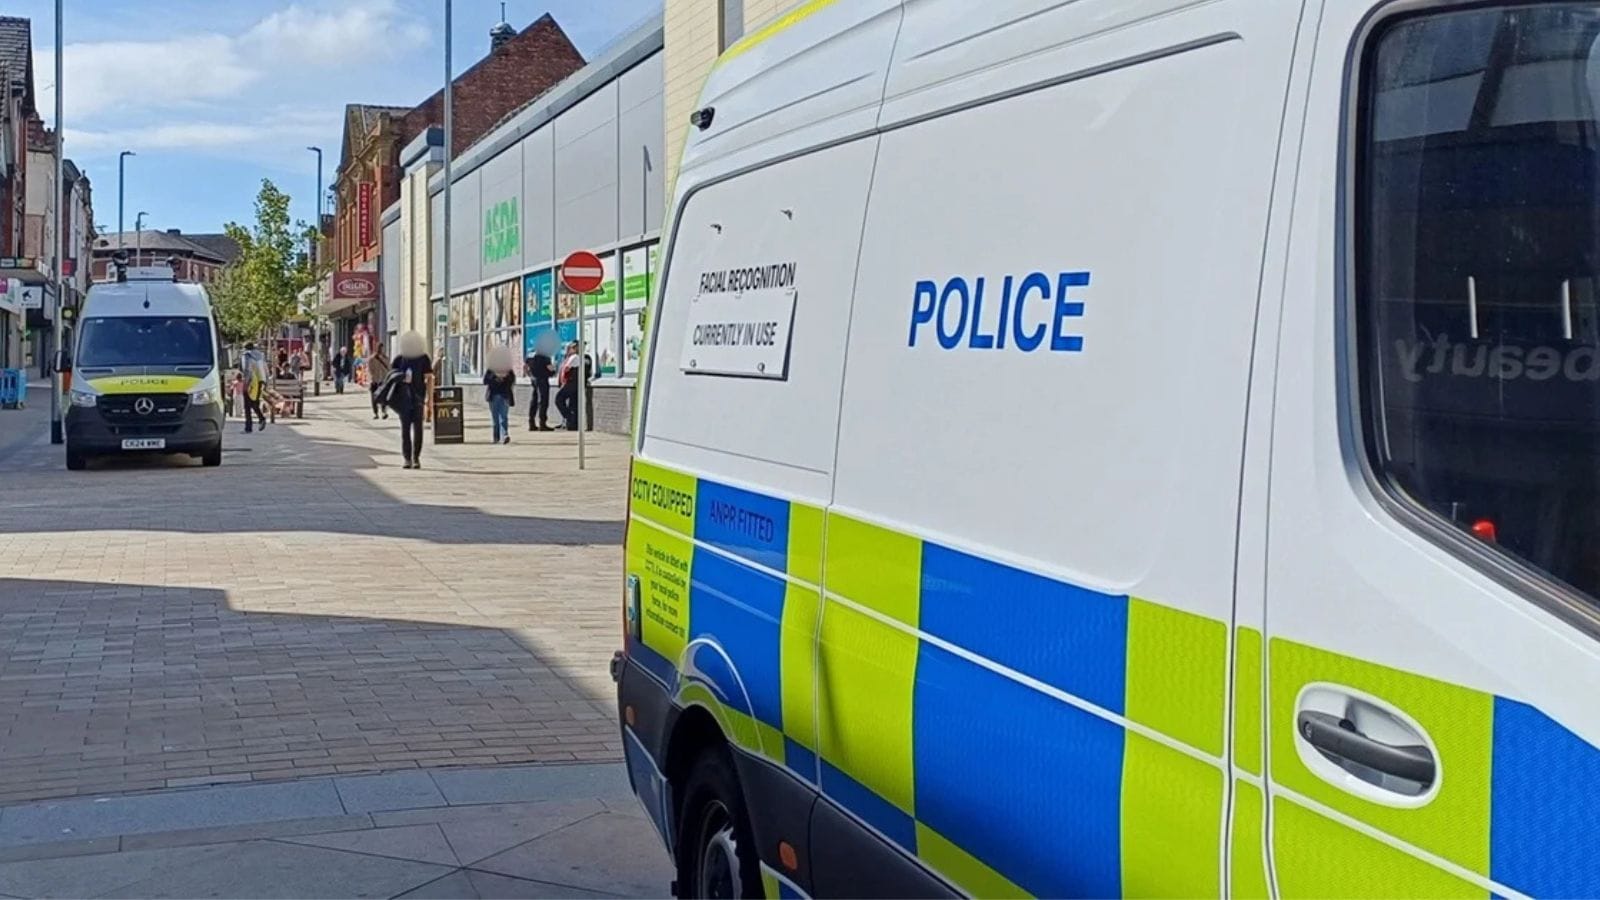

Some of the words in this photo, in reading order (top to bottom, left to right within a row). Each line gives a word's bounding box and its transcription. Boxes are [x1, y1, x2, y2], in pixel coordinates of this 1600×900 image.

[699, 271, 726, 294] FACIAL
[728, 262, 797, 291] RECOGNITION
[908, 271, 1090, 352] POLICE
[693, 323, 744, 346] CURRENTLY
[742, 323, 756, 346] IN
[756, 322, 778, 346] USE
[120, 378, 169, 386] POLICE
[632, 477, 652, 501] CCTV
[651, 484, 693, 518] EQUIPPED
[709, 500, 737, 531] ANPR
[737, 508, 775, 544] FITTED
